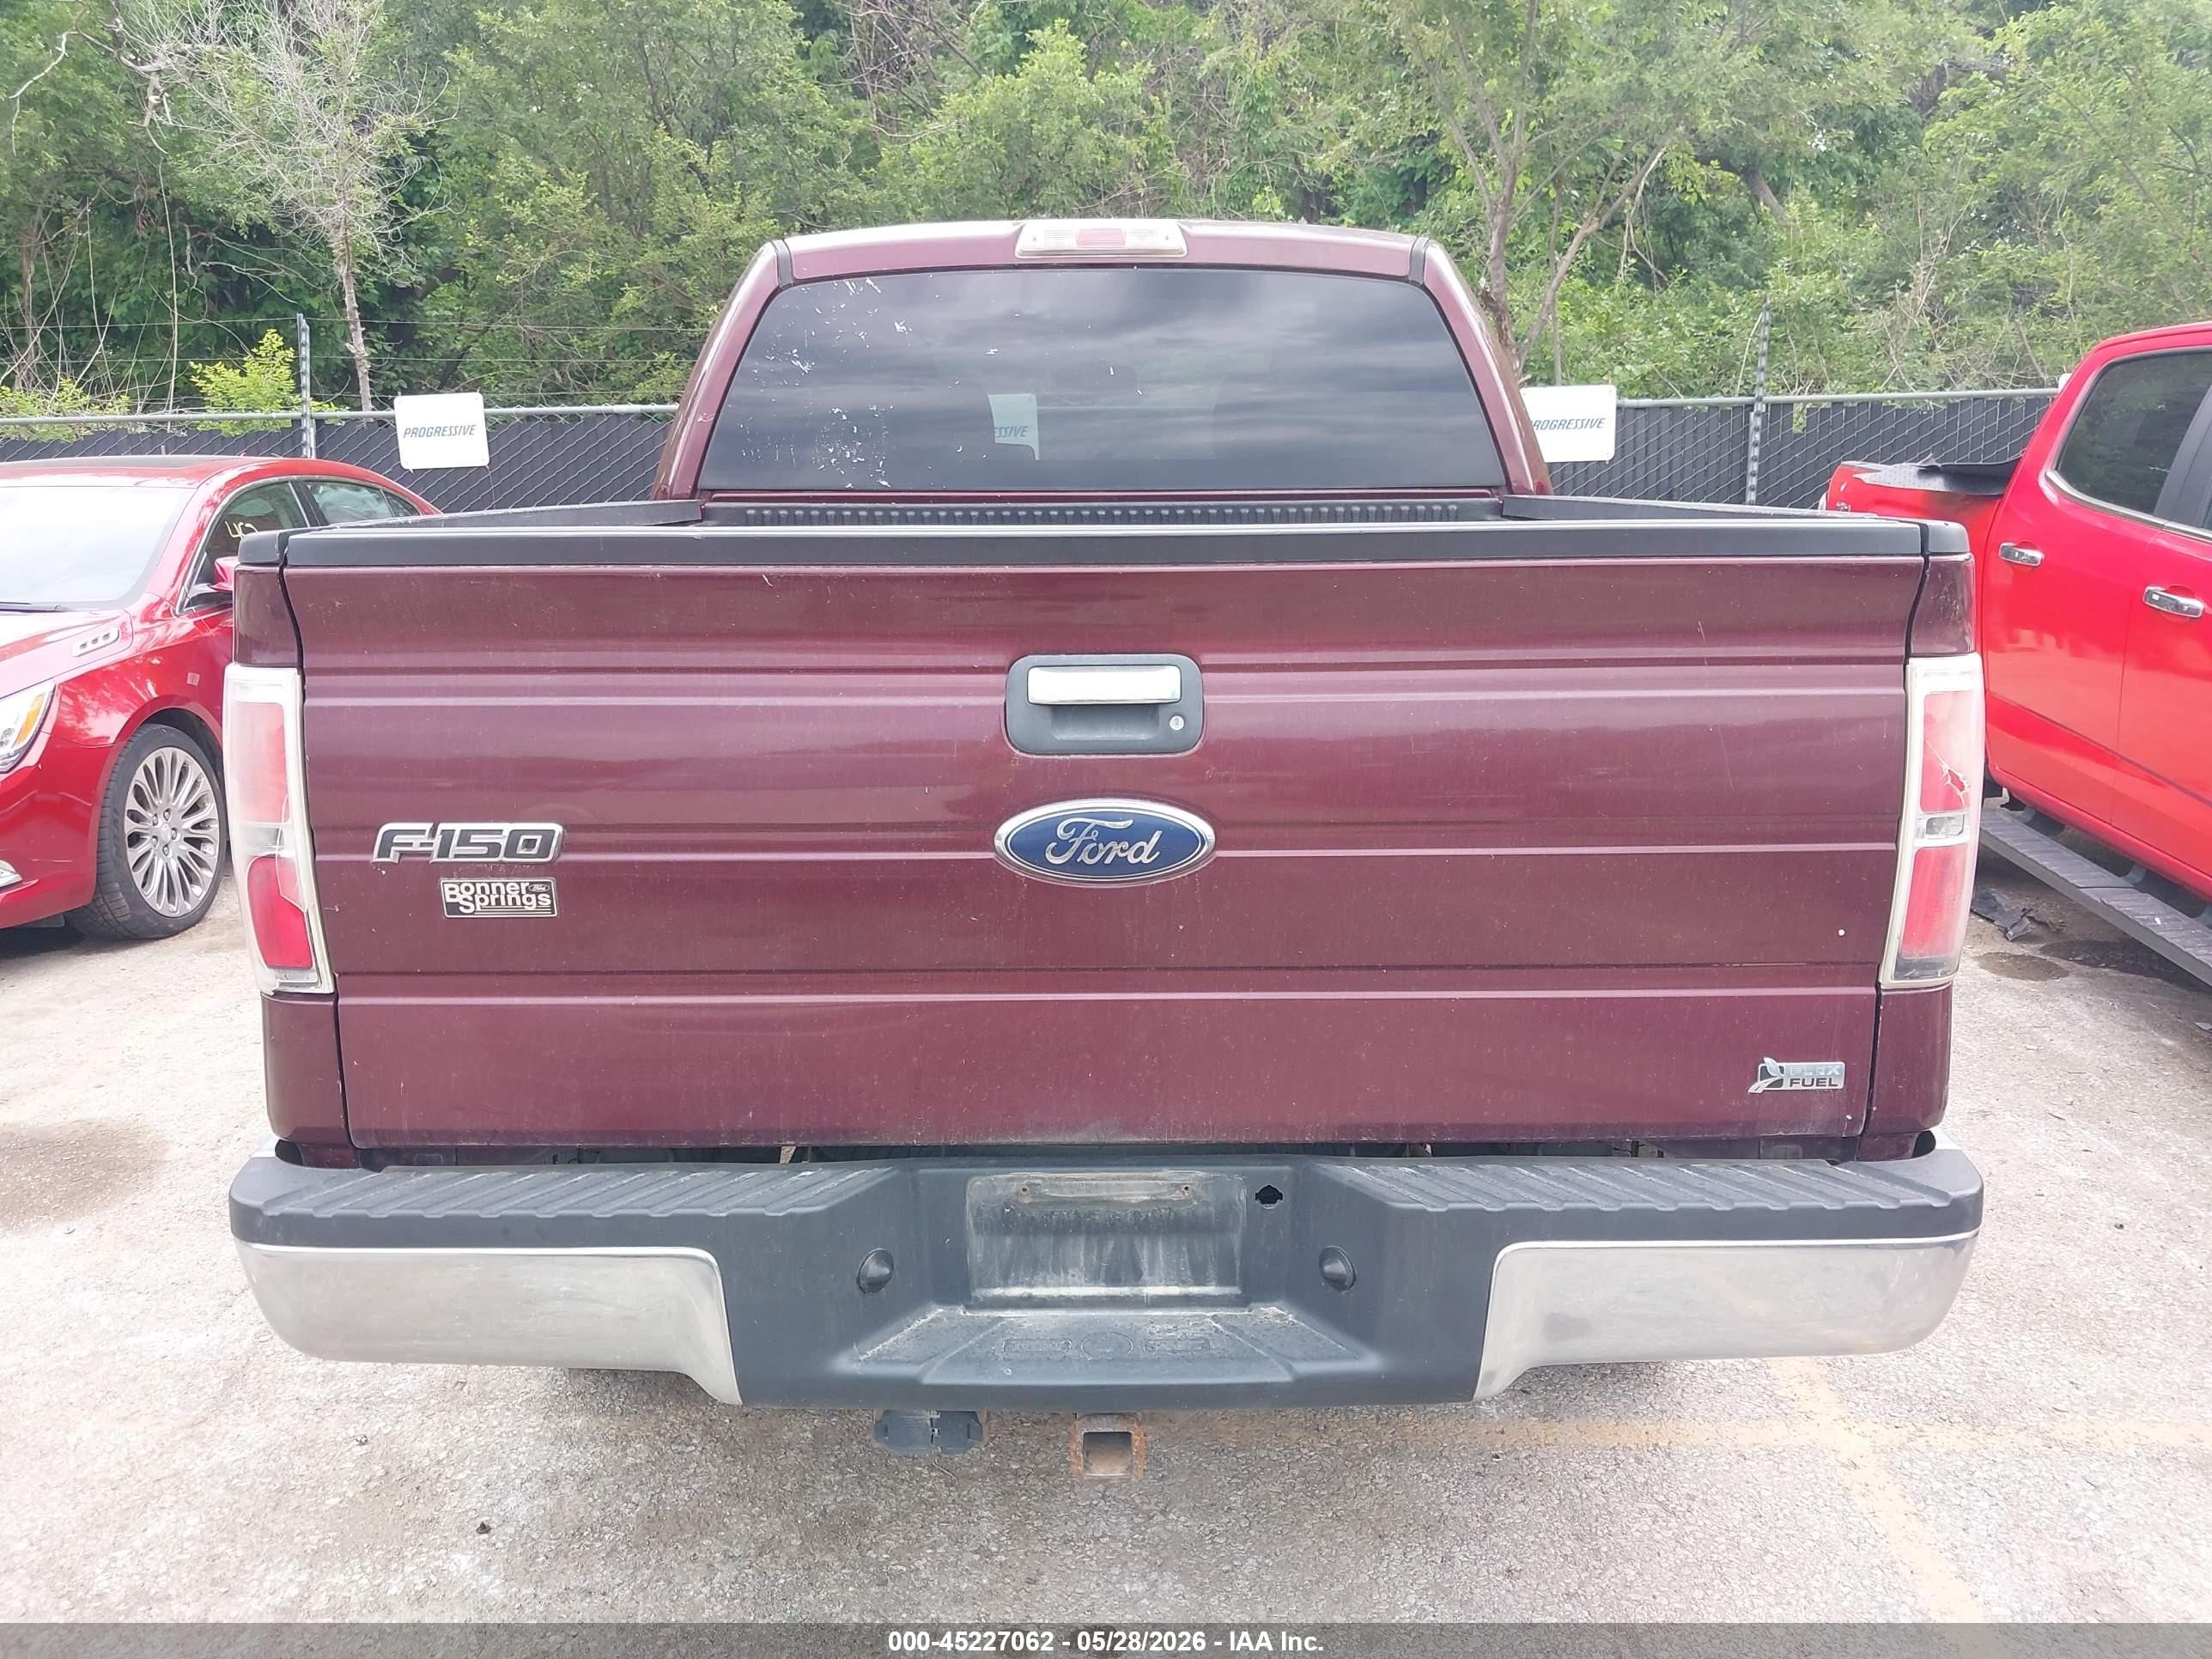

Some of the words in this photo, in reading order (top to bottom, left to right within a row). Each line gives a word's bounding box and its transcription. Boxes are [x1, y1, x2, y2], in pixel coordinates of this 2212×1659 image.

[403, 424, 477, 439] PROGRESSIVE
[1531, 417, 1607, 431] ROGRESSIVE
[372, 823, 563, 863] F-150
[1045, 817, 1163, 865] Ford
[443, 882, 529, 902] Bonner
[459, 893, 551, 914] Springs
[1790, 1078, 1838, 1088] FUEL
